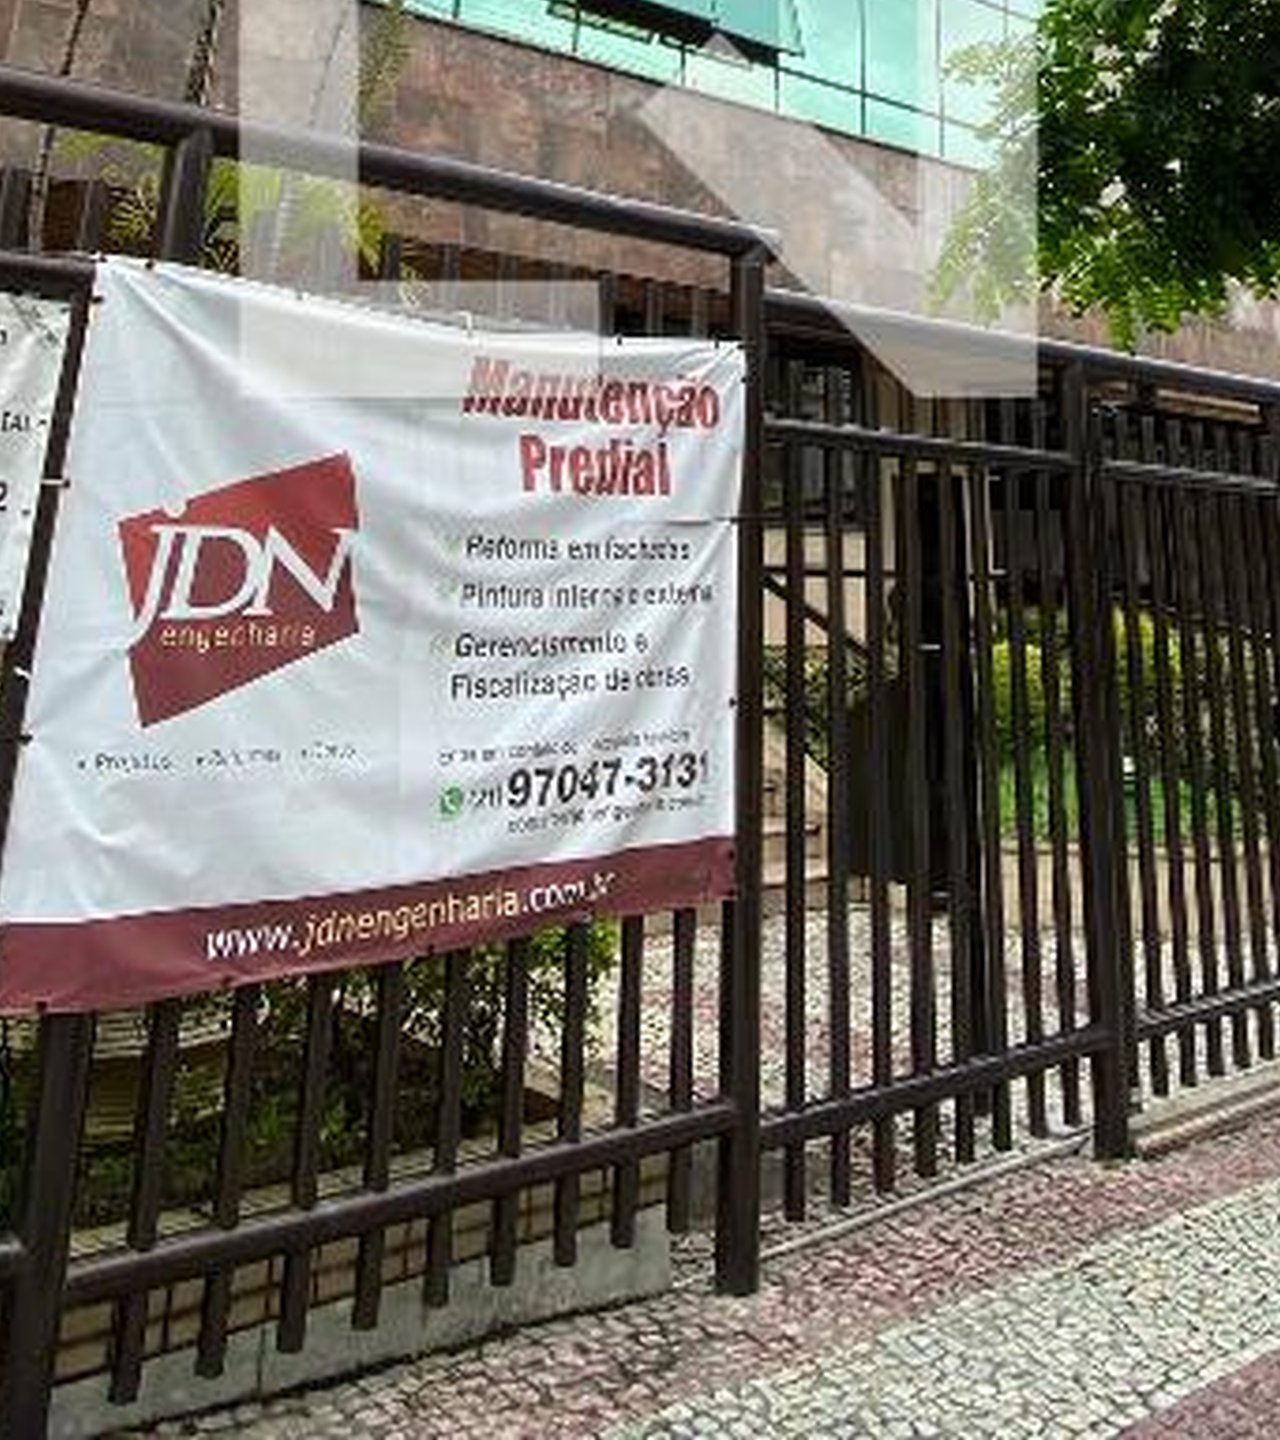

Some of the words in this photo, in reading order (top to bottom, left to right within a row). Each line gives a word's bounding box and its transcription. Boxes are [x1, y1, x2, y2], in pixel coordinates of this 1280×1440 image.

[463, 356, 721, 432] Manutenção
[519, 433, 672, 497] Predial
[460, 582, 544, 608] Pintura
[161, 620, 316, 654] engenharia
[604, 666, 631, 692] de
[507, 750, 710, 810] 97047-3131
